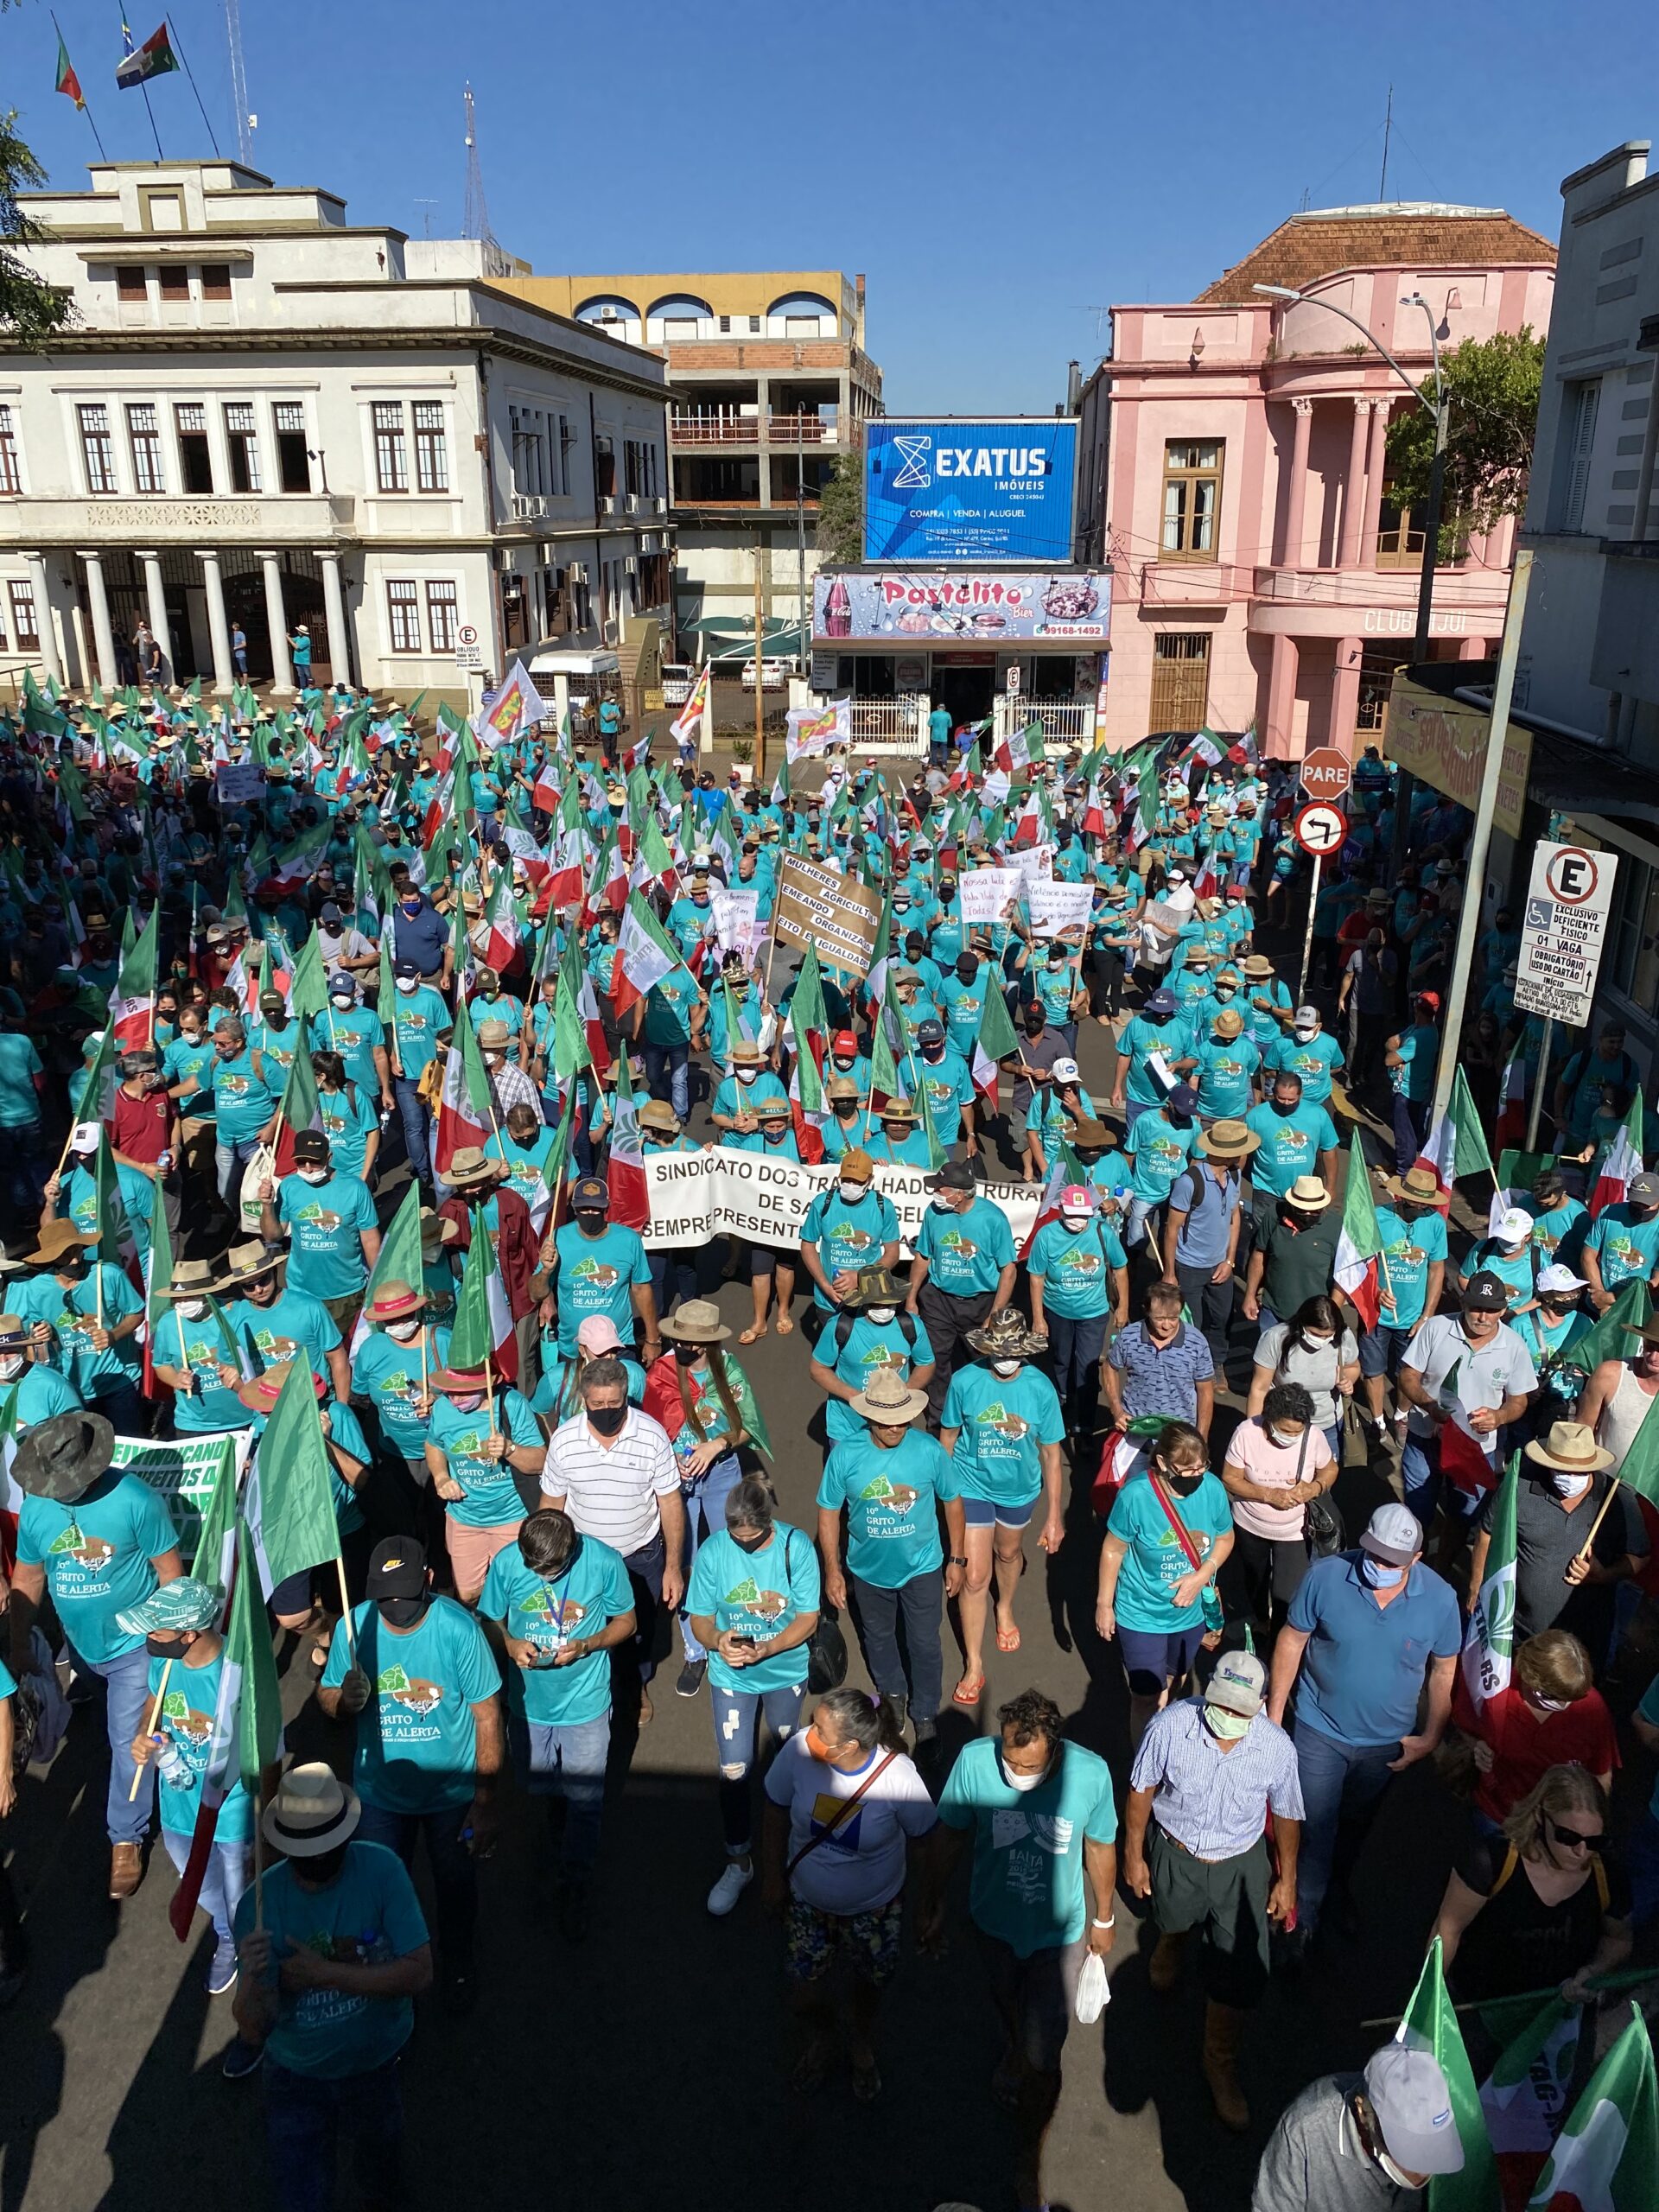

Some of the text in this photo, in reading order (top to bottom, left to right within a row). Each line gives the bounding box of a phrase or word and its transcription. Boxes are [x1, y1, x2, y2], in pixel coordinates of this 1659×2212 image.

[936, 448, 1046, 476] EXATUS
[995, 479, 1044, 491] IMÓVEIS
[910, 509, 1026, 518] COMPRA VENDA ALUGUEL
[883, 580, 1021, 605] Pastelito
[1013, 607, 1033, 618] Bier
[1364, 610, 1412, 632] CLUB
[465, 629, 472, 641] E
[1011, 672, 1016, 683] E
[1303, 766, 1347, 784] PARE
[787, 858, 838, 888] MULHERES
[1560, 859, 1586, 896] E
[1555, 904, 1598, 921] EXCLUSIVO
[778, 918, 799, 933] EITO
[1554, 915, 1599, 932] DEFICIENTE
[1538, 935, 1582, 956] 01 VAGA
[1535, 950, 1583, 969] OBRIGATÓRIO
[1531, 960, 1580, 980] USO DO CARTÃO
[1543, 976, 1564, 988] INÍCIO
[657, 1158, 752, 1182] SINDICATO
[759, 1165, 799, 1187] DOS
[759, 1193, 784, 1211] DE
[643, 1213, 712, 1237] SEMPRE
[988, 1448, 1021, 1459] ALERTA
[457, 1467, 484, 1477] GRITO
[881, 1524, 916, 1535] ALERTA
[57, 1560, 69, 1569] 10º
[56, 1572, 86, 1581] GRITO
[56, 1583, 111, 1593] DE ALERTA
[729, 1612, 743, 1621] 10º
[525, 1622, 539, 1630] 10º
[753, 1630, 784, 1642] LERT
[379, 1704, 391, 1713] 0º
[396, 1726, 441, 1737] ALERTA
[187, 1753, 208, 1766] ERTA
